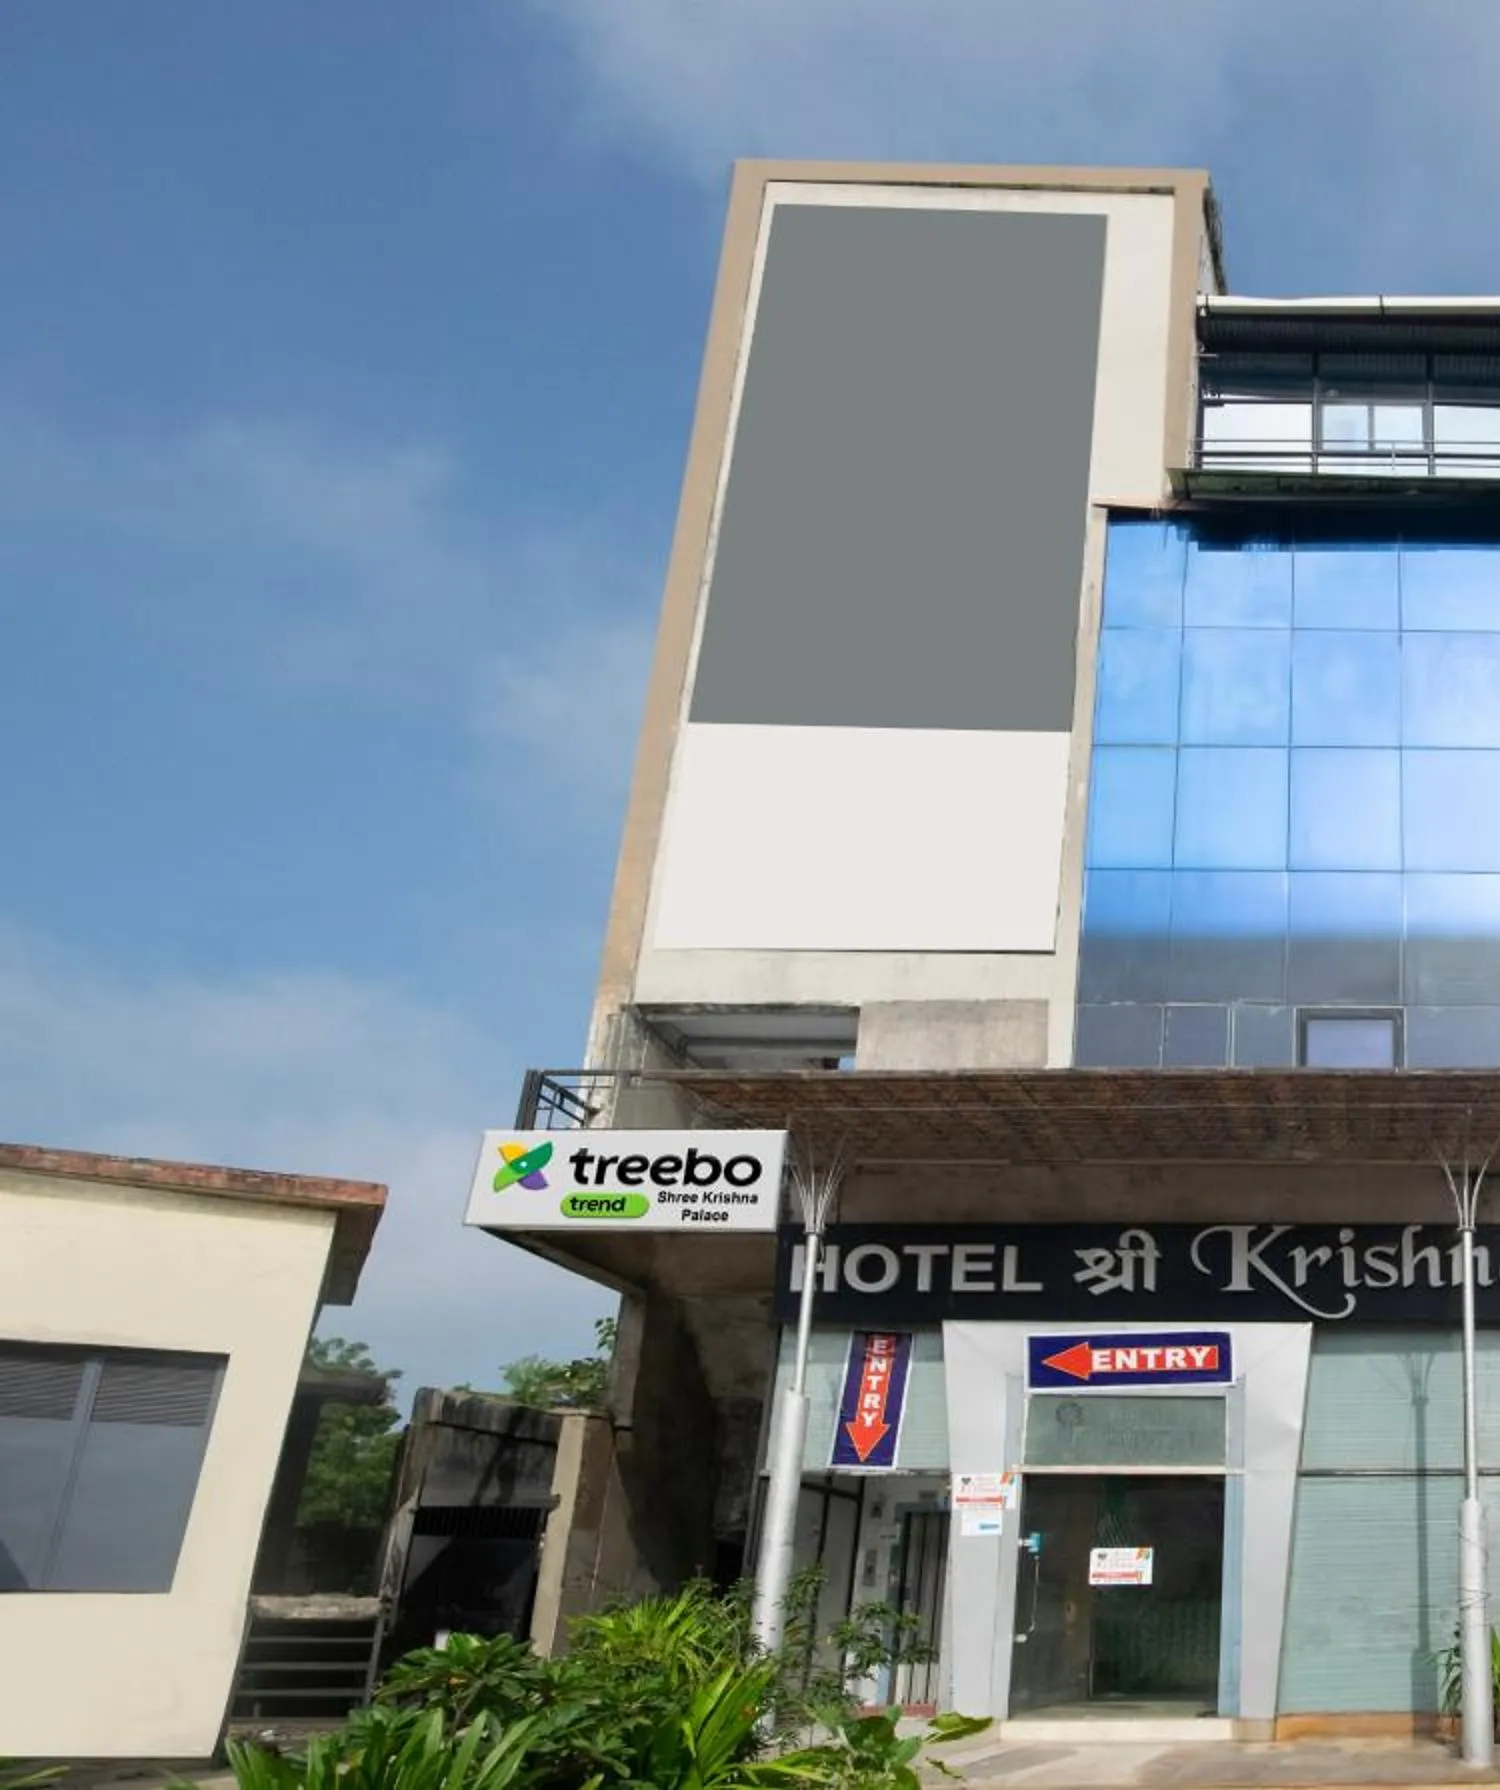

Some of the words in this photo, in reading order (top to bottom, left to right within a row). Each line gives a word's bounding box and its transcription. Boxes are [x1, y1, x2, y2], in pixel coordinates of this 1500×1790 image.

[569, 1148, 763, 1187] treebo
[570, 1196, 626, 1212] trend
[657, 1191, 698, 1204] Shree
[702, 1191, 759, 1204] Krishna
[681, 1209, 729, 1222] Palace
[789, 1243, 1044, 1293] HOTEL
[1073, 1228, 1161, 1296] श्री
[1091, 1346, 1212, 1371] ENTRY
[861, 1335, 891, 1427] ENTRY
